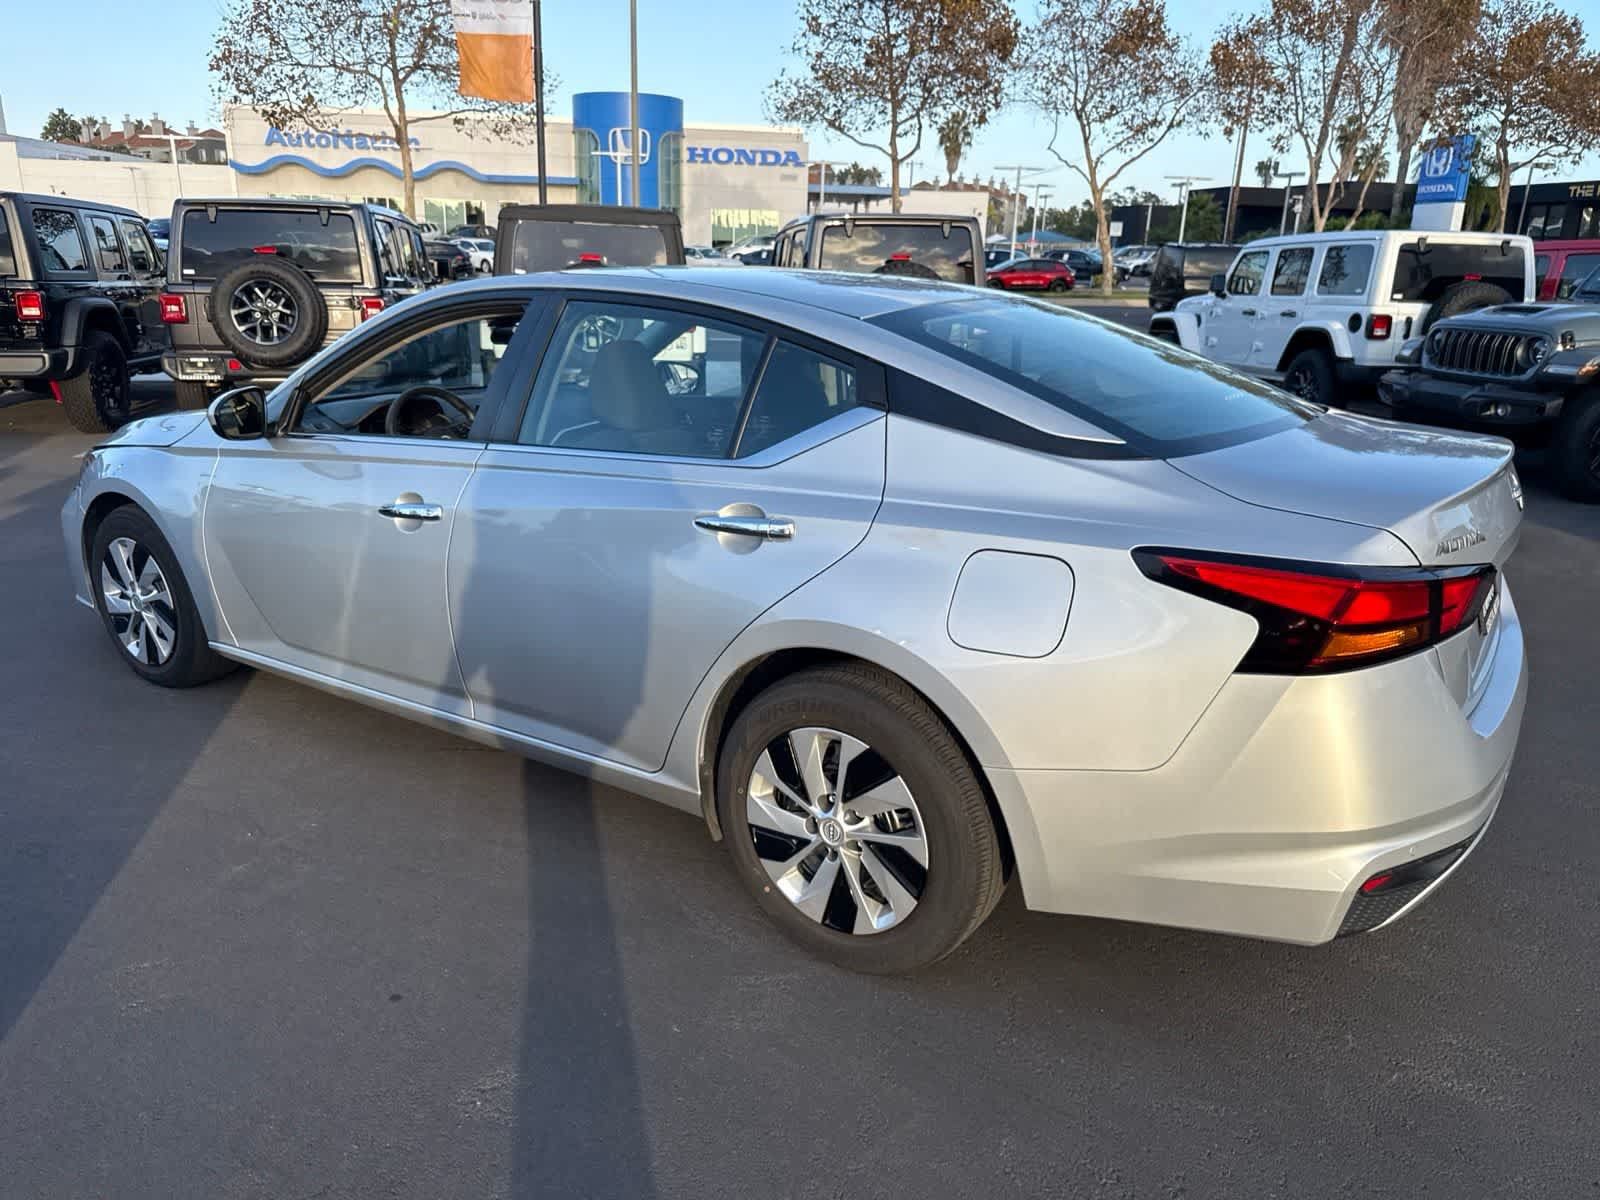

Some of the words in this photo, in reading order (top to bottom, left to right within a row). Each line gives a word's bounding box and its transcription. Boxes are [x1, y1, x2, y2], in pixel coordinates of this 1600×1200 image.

[265, 126, 420, 152] AutoNatin
[686, 146, 806, 168] HONDA
[1418, 183, 1455, 193] HONDA
[1568, 184, 1595, 198] THE
